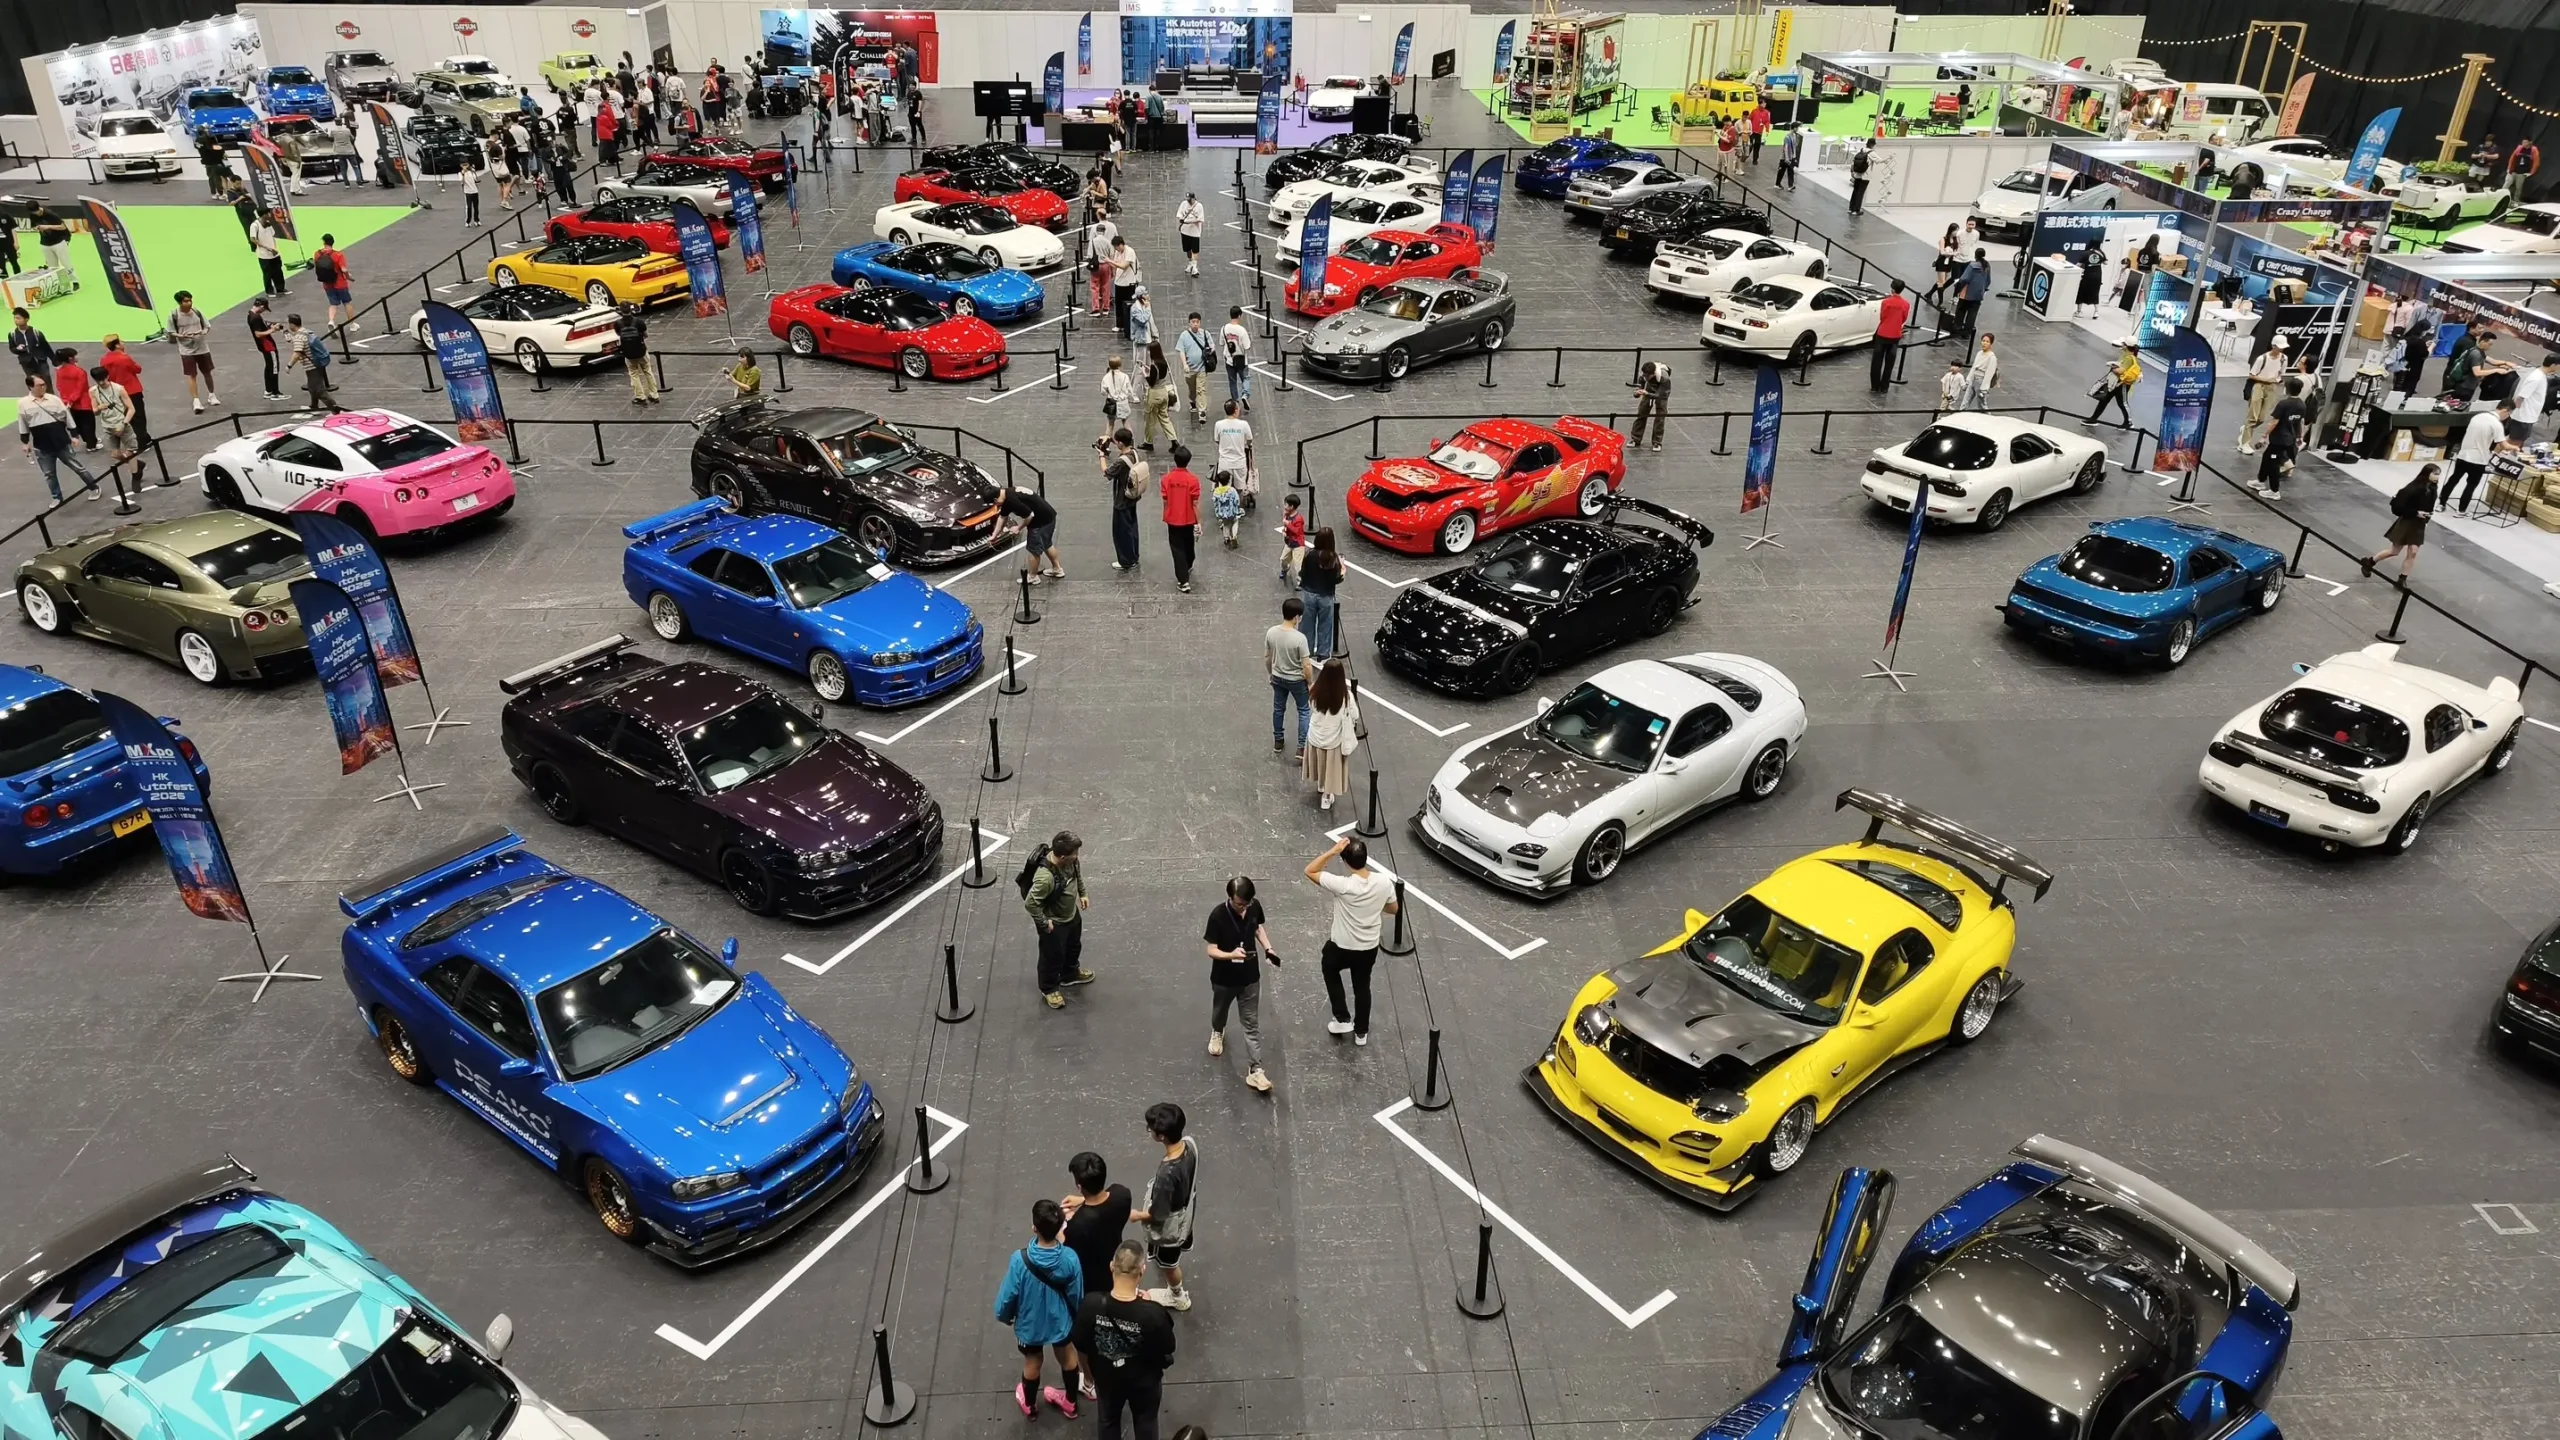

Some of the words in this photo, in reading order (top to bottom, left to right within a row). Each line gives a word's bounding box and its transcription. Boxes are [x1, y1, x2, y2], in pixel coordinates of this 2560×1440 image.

[337, 26, 361, 35] DATSUN
[454, 23, 478, 32] DATSUN
[572, 25, 596, 33] DATSUN
[1219, 21, 1247, 36] 2026
[1775, 20, 1788, 64] DUNLOP
[2111, 171, 2124, 183] Crazy
[2276, 207, 2300, 217] Crazy
[2301, 207, 2332, 217] Charge
[2429, 287, 2448, 302] Parts
[2448, 294, 2476, 312] Central
[2475, 304, 2527, 334] (Automobile)
[2527, 321, 2556, 343] Global
[2499, 461, 2521, 476] BLITZ
[1532, 482, 1552, 501] 95
[317, 543, 365, 564] IMXpo
[341, 566, 358, 578] HK
[311, 608, 350, 637] IMXpo
[331, 634, 344, 648] HK
[322, 633, 362, 665] Autofest
[332, 646, 356, 667] 2026
[124, 743, 175, 759] IMXpo
[152, 773, 170, 781] HK
[150, 792, 186, 801] 2026
[119, 812, 145, 830] G7R
[1713, 955, 1806, 1011] THE-LOWDOWN.COM
